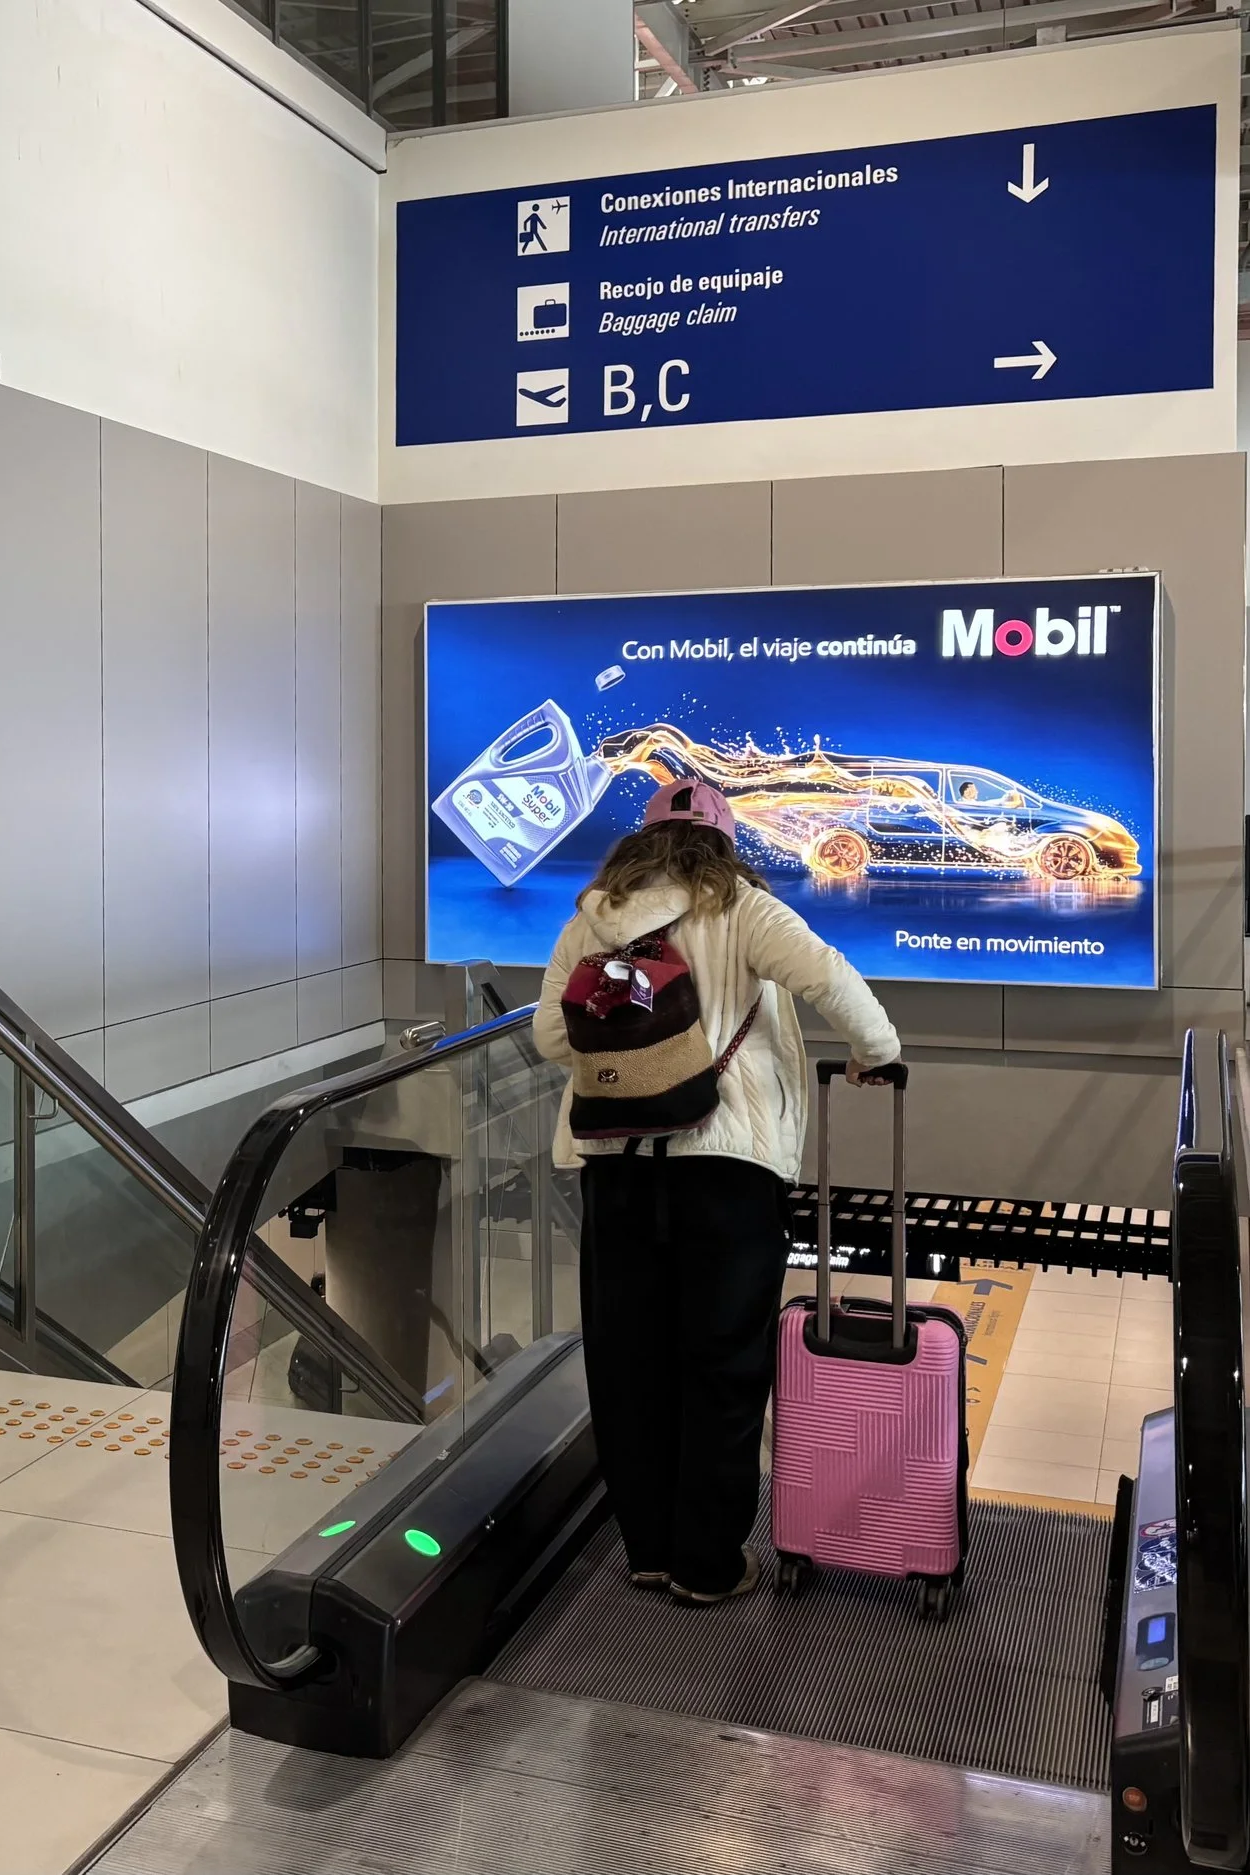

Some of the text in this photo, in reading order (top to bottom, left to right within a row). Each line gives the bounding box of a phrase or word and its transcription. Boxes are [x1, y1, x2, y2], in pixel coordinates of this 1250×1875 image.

[600, 164, 899, 214] Conexiones Internacionales
[599, 205, 821, 247] International transfers
[600, 266, 784, 300] Recojo de equipaje
[598, 301, 738, 336] Baggage claim
[603, 359, 690, 422] B,C
[622, 634, 917, 663] Con Mobil, el viaje continúa
[522, 793, 551, 823] Super
[531, 785, 562, 816] Mobil
[895, 930, 1105, 956] Ponte en movimiento
